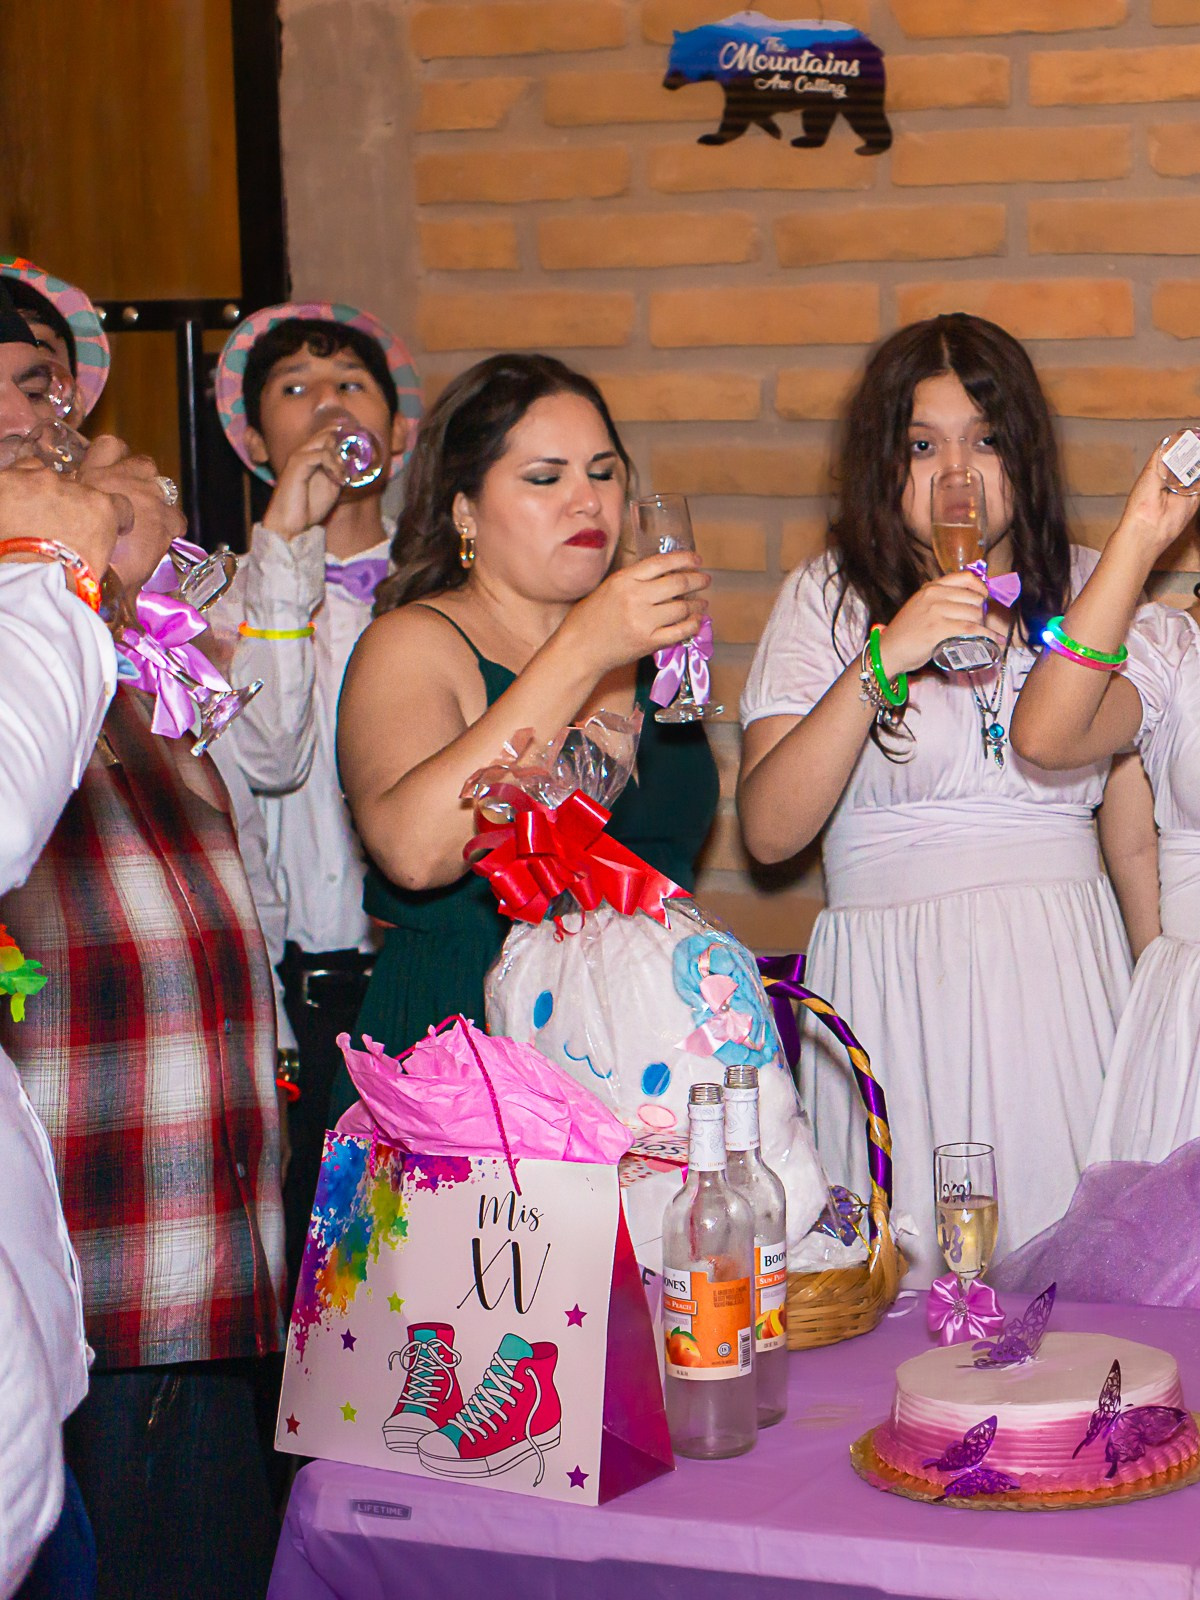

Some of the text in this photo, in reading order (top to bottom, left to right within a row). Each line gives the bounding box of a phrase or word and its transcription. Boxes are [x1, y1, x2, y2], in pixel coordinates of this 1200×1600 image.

[719, 41, 860, 77] Mountains
[761, 36, 788, 53] The
[754, 73, 848, 99] Are Calling
[479, 1190, 544, 1231] Mis
[457, 1237, 551, 1314] XV
[358, 1503, 403, 1516] LIFETIME
